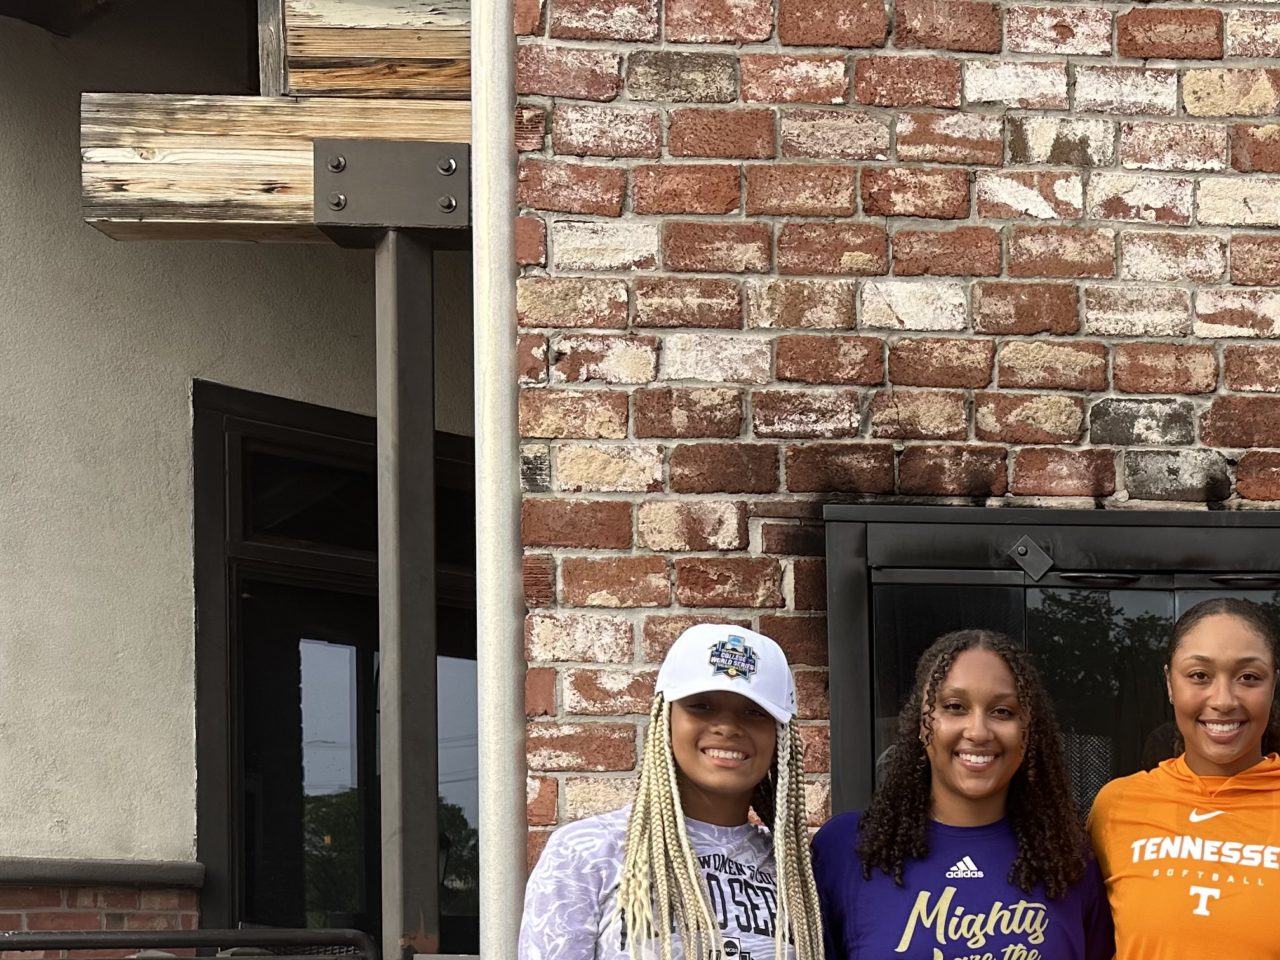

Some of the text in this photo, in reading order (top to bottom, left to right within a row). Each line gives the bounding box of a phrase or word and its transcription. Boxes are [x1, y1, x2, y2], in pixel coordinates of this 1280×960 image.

[710, 656, 733, 666] WORLD
[946, 869, 984, 878] adidas
[1152, 868, 1265, 887] SOFTBALL
[1189, 885, 1221, 917] T
[894, 886, 1049, 953] Mighty
